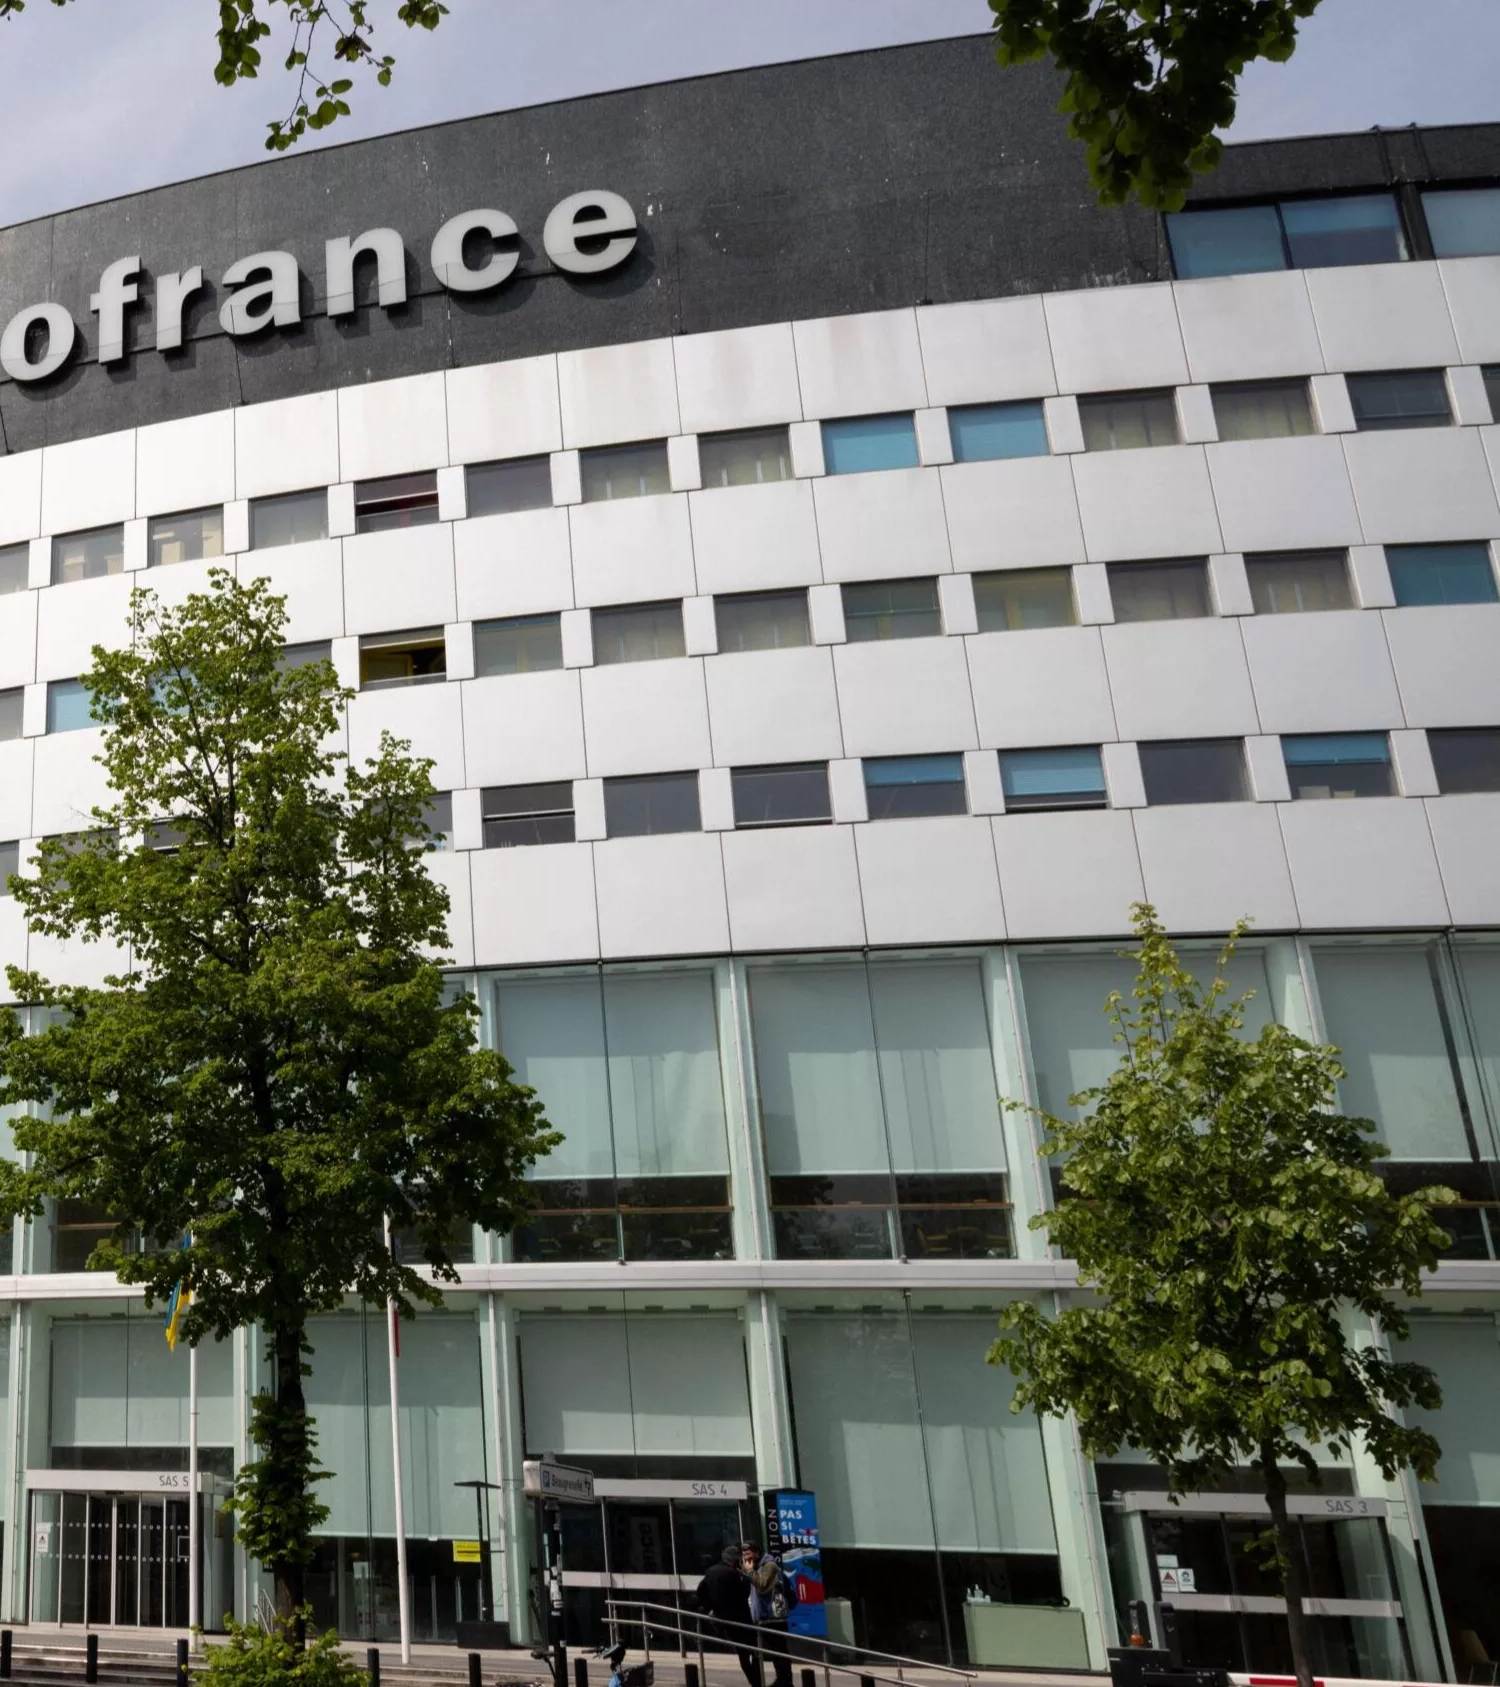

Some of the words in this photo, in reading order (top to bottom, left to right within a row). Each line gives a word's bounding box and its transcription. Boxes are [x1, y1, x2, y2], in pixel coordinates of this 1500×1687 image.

[159, 1475, 178, 1487] SAS
[182, 1475, 189, 1487] 5
[691, 1483, 715, 1496] SAS
[720, 1483, 727, 1497] 4
[1325, 1499, 1354, 1513] SAS
[1358, 1500, 1368, 1514] 3
[779, 1509, 802, 1519] PAS
[781, 1521, 792, 1531] SI
[768, 1508, 781, 1563] SITION
